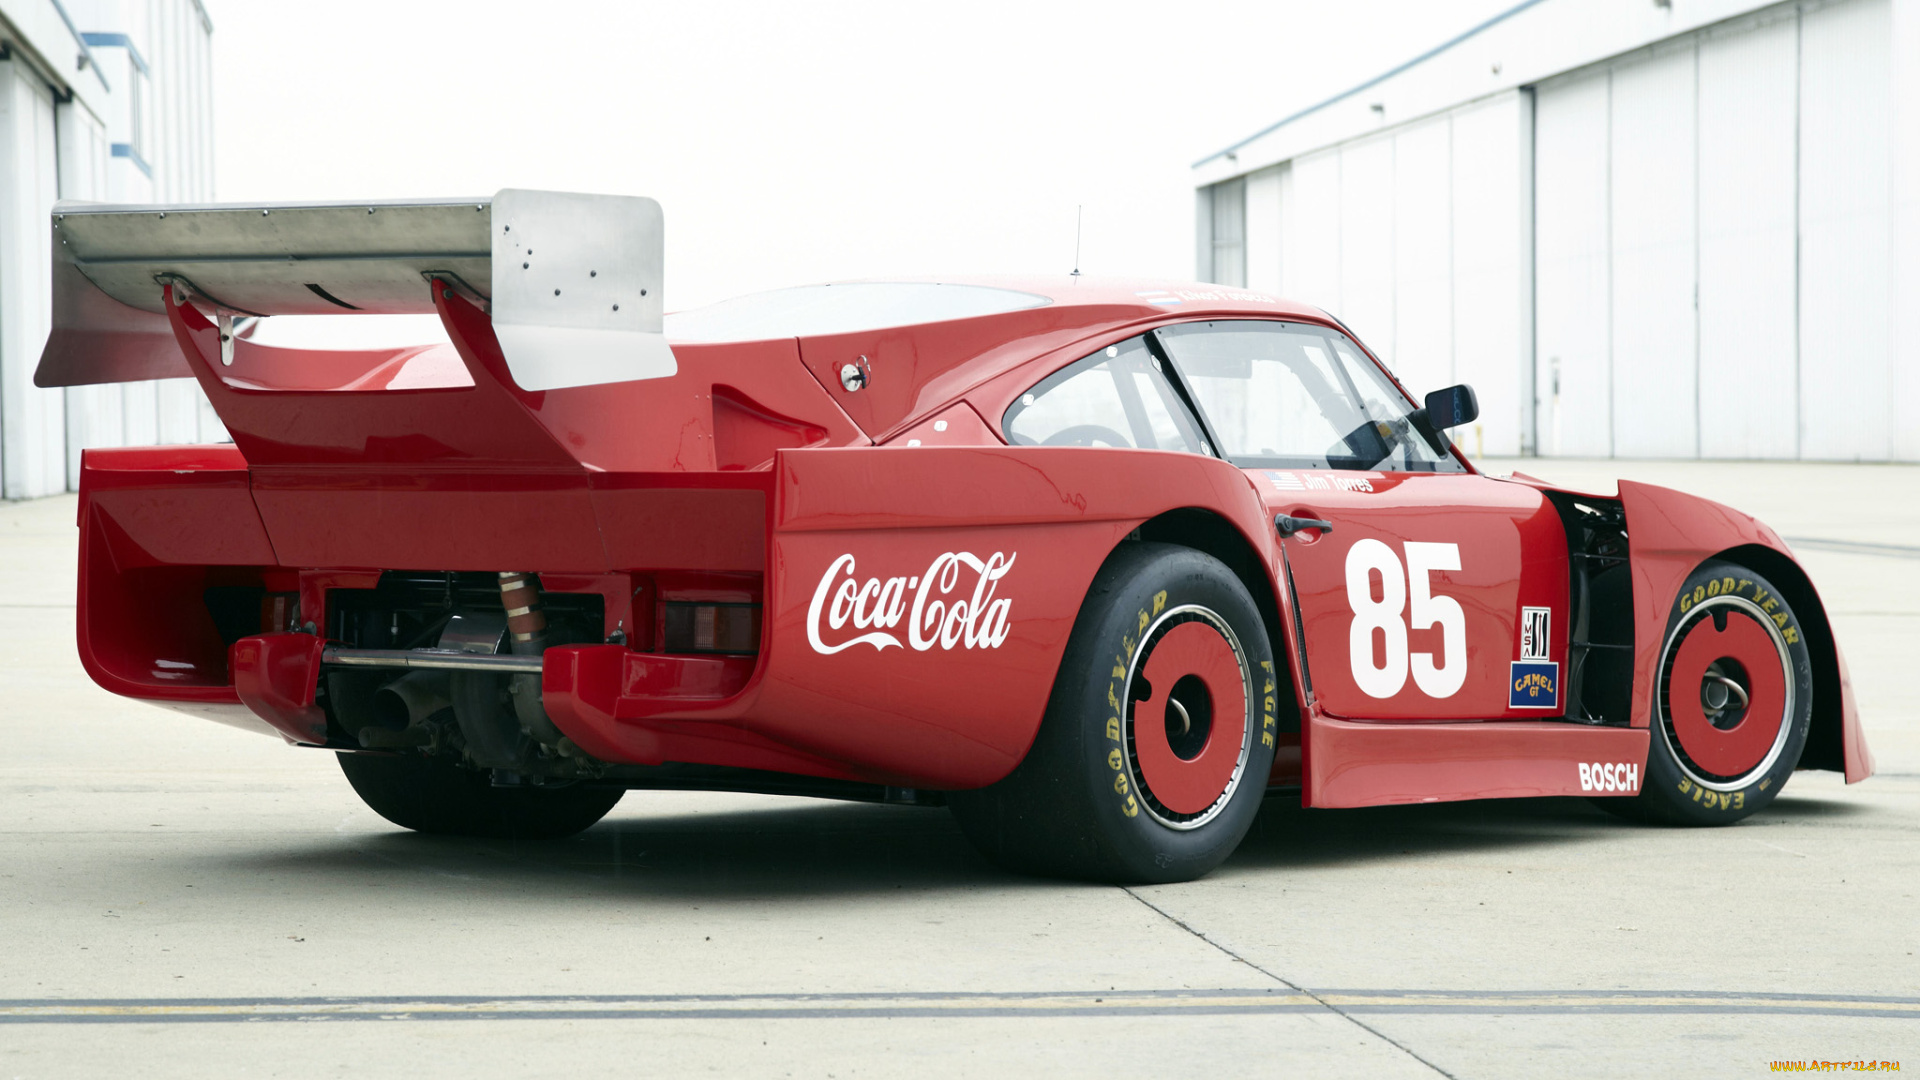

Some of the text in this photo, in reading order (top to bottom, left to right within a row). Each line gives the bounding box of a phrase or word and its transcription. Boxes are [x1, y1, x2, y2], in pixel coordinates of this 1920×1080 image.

[1303, 473, 1374, 492] Jim Torres
[806, 551, 1017, 655] Coca-Cola
[1345, 538, 1468, 699] 85
[1680, 577, 1800, 646] GOODYEAR
[1523, 612, 1532, 657] IMSA
[1514, 673, 1554, 693] CAMEL
[1529, 685, 1539, 698] GT
[1578, 762, 1638, 792] BOSCH
[1677, 776, 1745, 811] EAGLE
